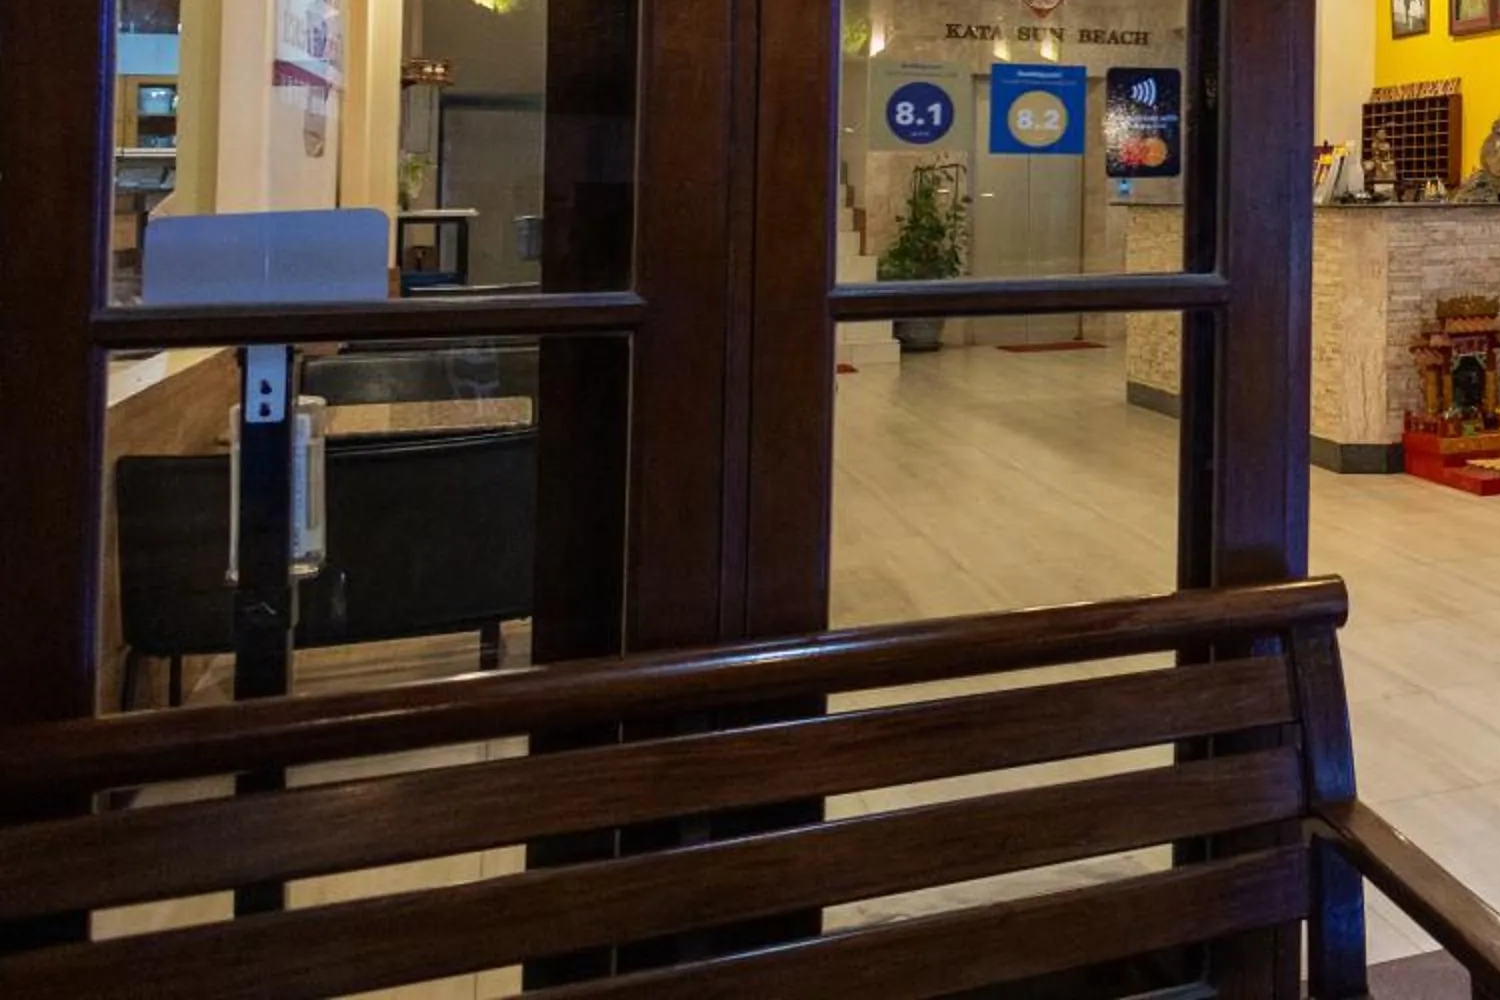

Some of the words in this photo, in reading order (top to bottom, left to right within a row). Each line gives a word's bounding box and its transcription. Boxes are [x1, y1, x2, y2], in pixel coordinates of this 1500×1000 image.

[1017, 26, 1065, 43] SUN
[1078, 28, 1151, 46] BEACH
[895, 101, 943, 126] 8.1
[1016, 108, 1061, 131] 8.2
